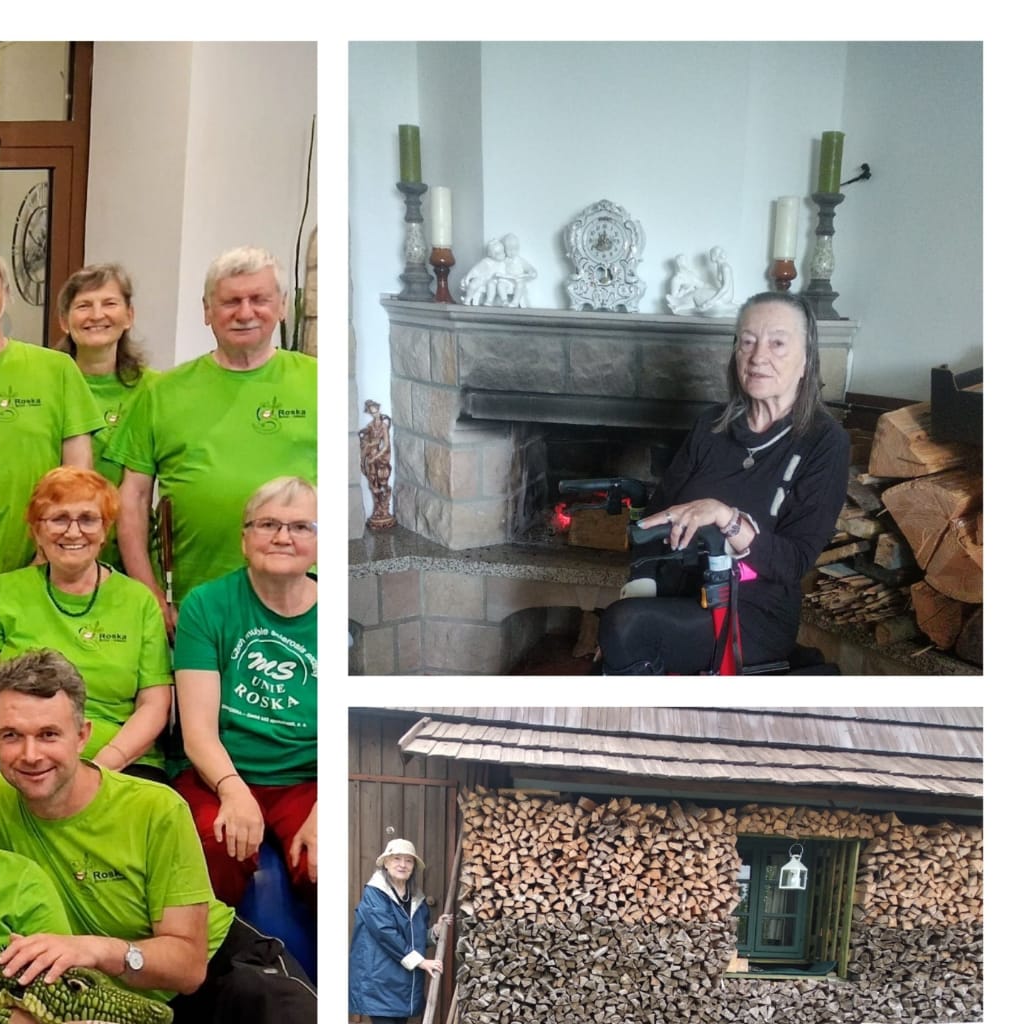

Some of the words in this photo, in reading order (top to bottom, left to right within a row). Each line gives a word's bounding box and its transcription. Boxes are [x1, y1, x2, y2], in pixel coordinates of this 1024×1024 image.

[247, 651, 297, 681] MS
[234, 682, 300, 711] ROSKA
[251, 675, 286, 694] UNIE
